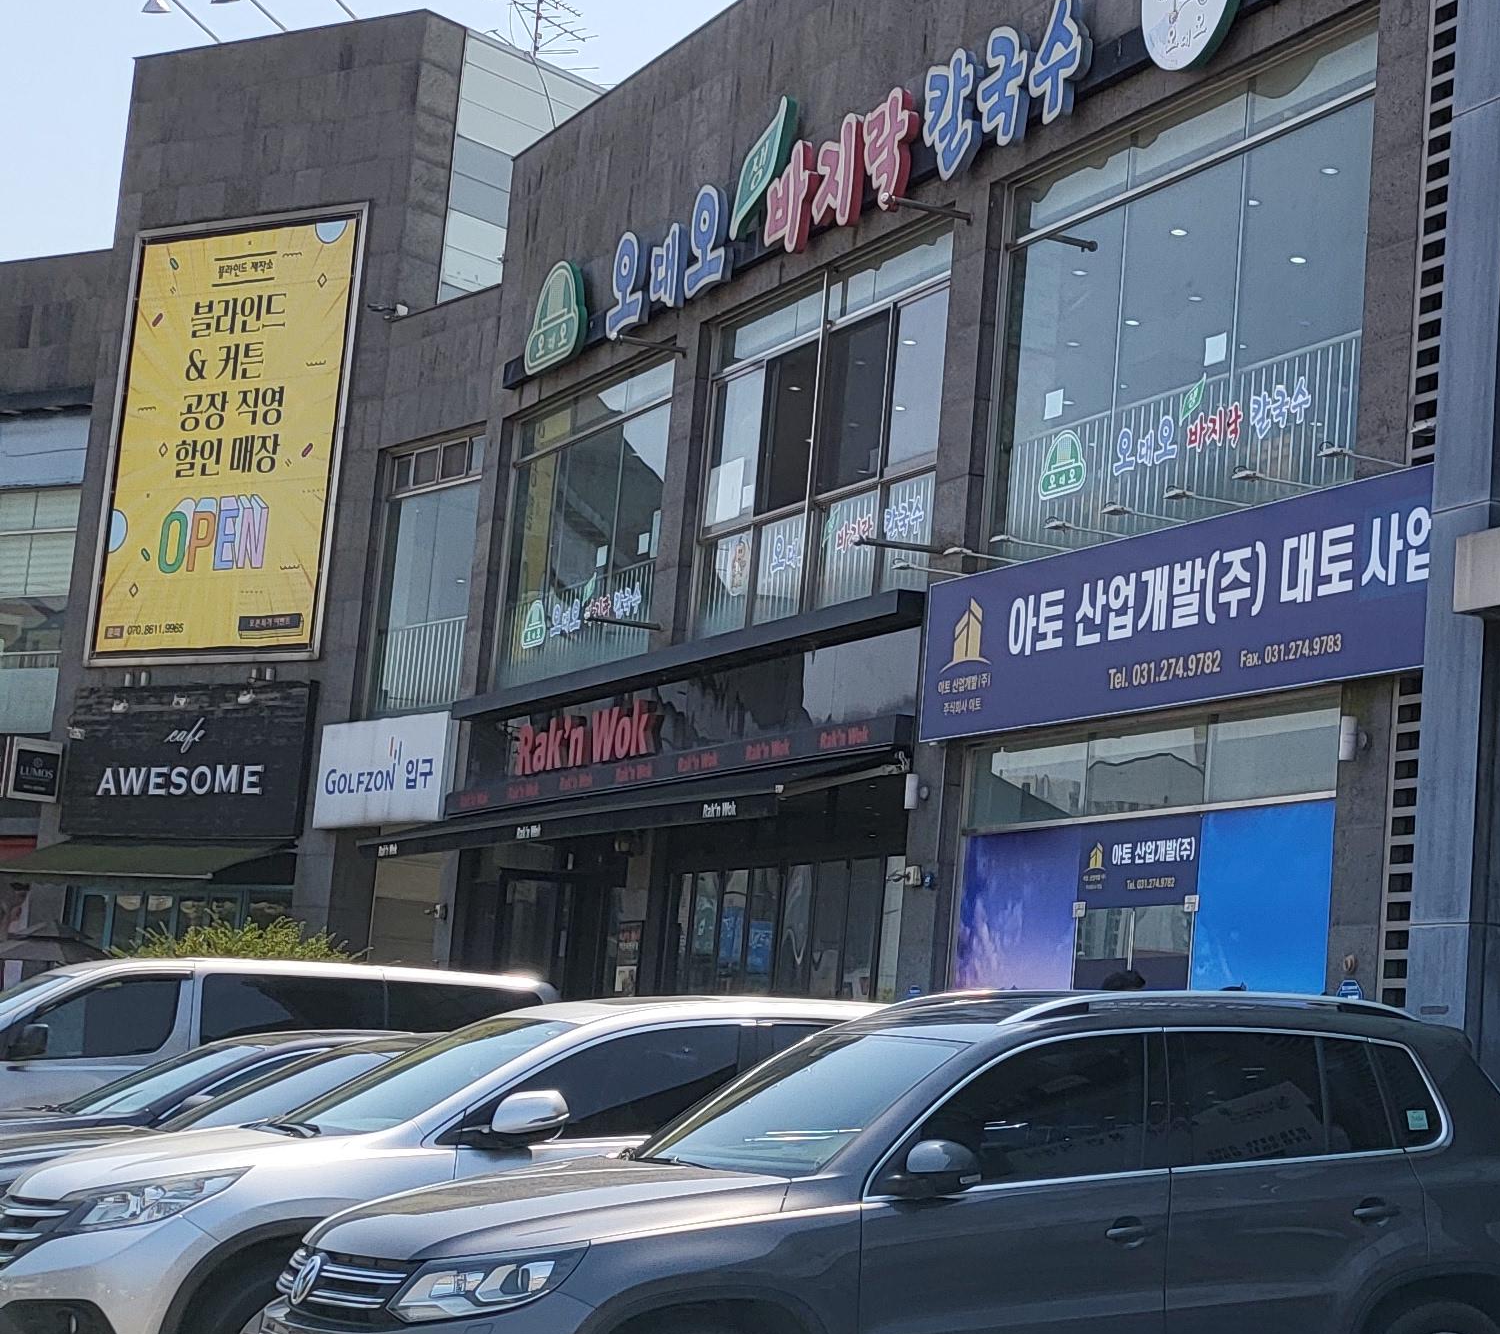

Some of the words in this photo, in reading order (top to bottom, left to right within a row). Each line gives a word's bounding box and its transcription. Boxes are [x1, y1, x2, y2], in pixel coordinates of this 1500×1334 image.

[1165, 13, 1208, 55] 오대오
[605, 184, 728, 340] 오대오
[763, 87, 909, 253] 바지락
[191, 293, 287, 339] 블라인드
[185, 349, 209, 381] &
[215, 341, 264, 381] 커튼
[180, 391, 229, 432] 공장
[235, 386, 285, 426] 직영
[1113, 415, 1178, 476] 오대오
[1186, 402, 1243, 452] 바지락
[1250, 377, 1311, 439] 칼국수
[175, 438, 223, 478] 할인
[229, 433, 281, 474] 매장
[1047, 470, 1077, 490] 오대오
[158, 495, 269, 573] OPEN
[1008, 589, 1065, 656] 아토
[1075, 540, 1266, 647] 산업개발(주)
[1108, 667, 1129, 691] Tel.
[1132, 649, 1222, 687] 031.274.9782
[1240, 650, 1262, 668] Fax.
[1264, 633, 1342, 663] 031.274.9783
[164, 717, 206, 754] cafe
[514, 715, 584, 776] Rak'n
[592, 699, 650, 763] Wok
[96, 765, 264, 796] AWESOME
[325, 763, 397, 795] GOLFZON
[405, 758, 433, 790] 입구
[1112, 842, 1133, 865] 아토
[1134, 836, 1196, 864] 산업개발(주)
